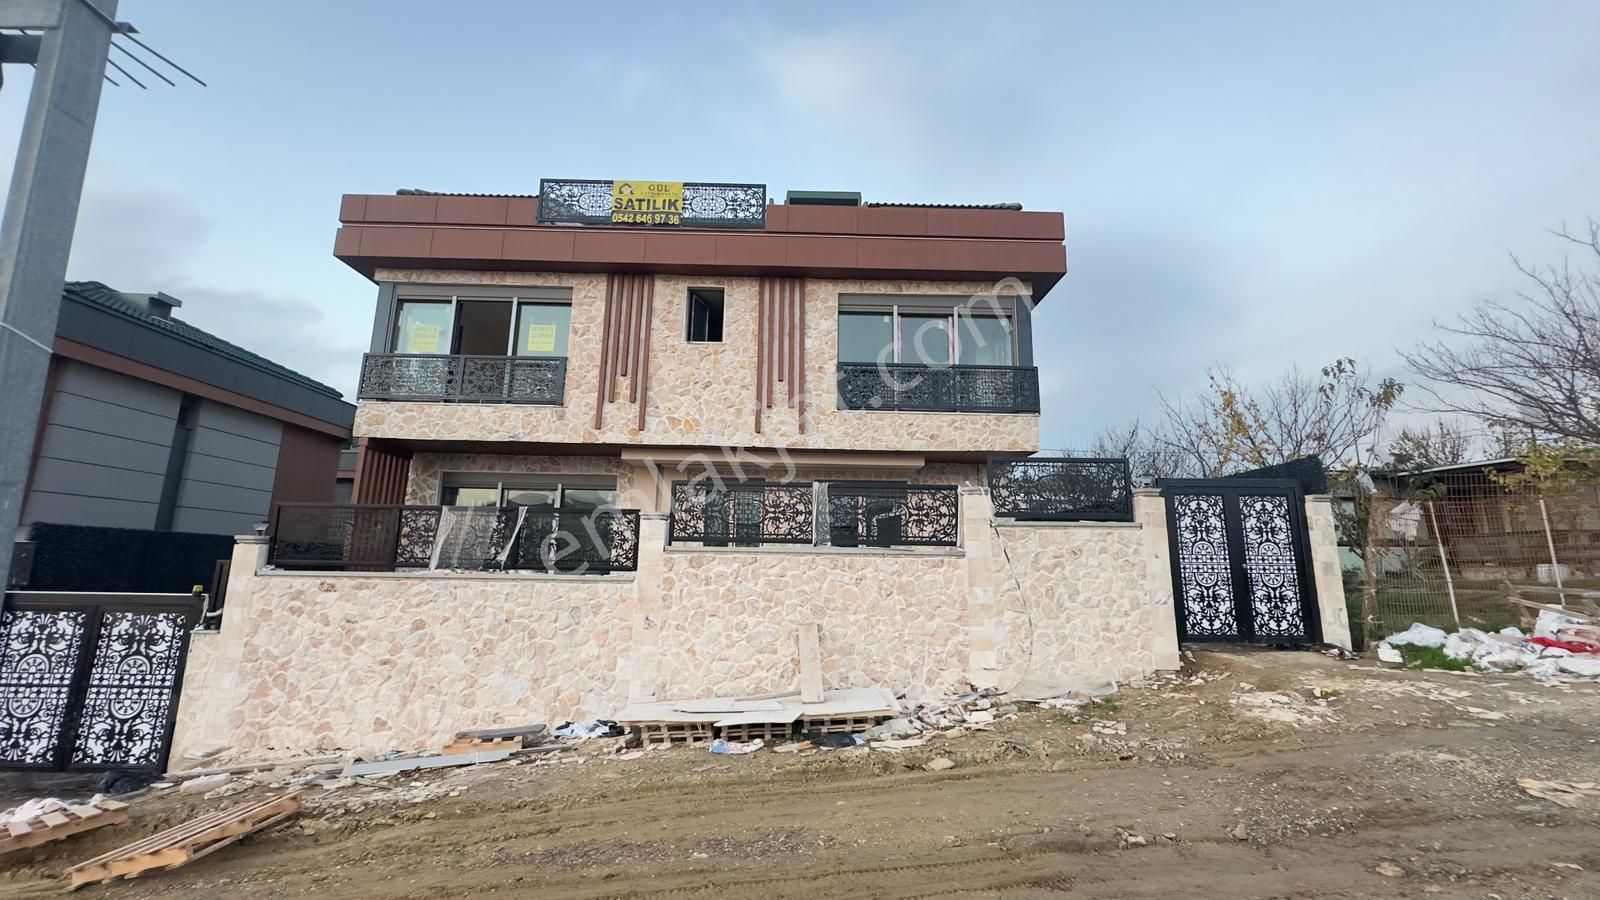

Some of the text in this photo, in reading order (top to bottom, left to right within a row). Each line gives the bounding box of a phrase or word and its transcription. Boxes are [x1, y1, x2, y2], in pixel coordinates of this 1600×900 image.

[613, 197, 679, 211] SATILIK
[612, 213, 680, 225] 0542 646 97 36
